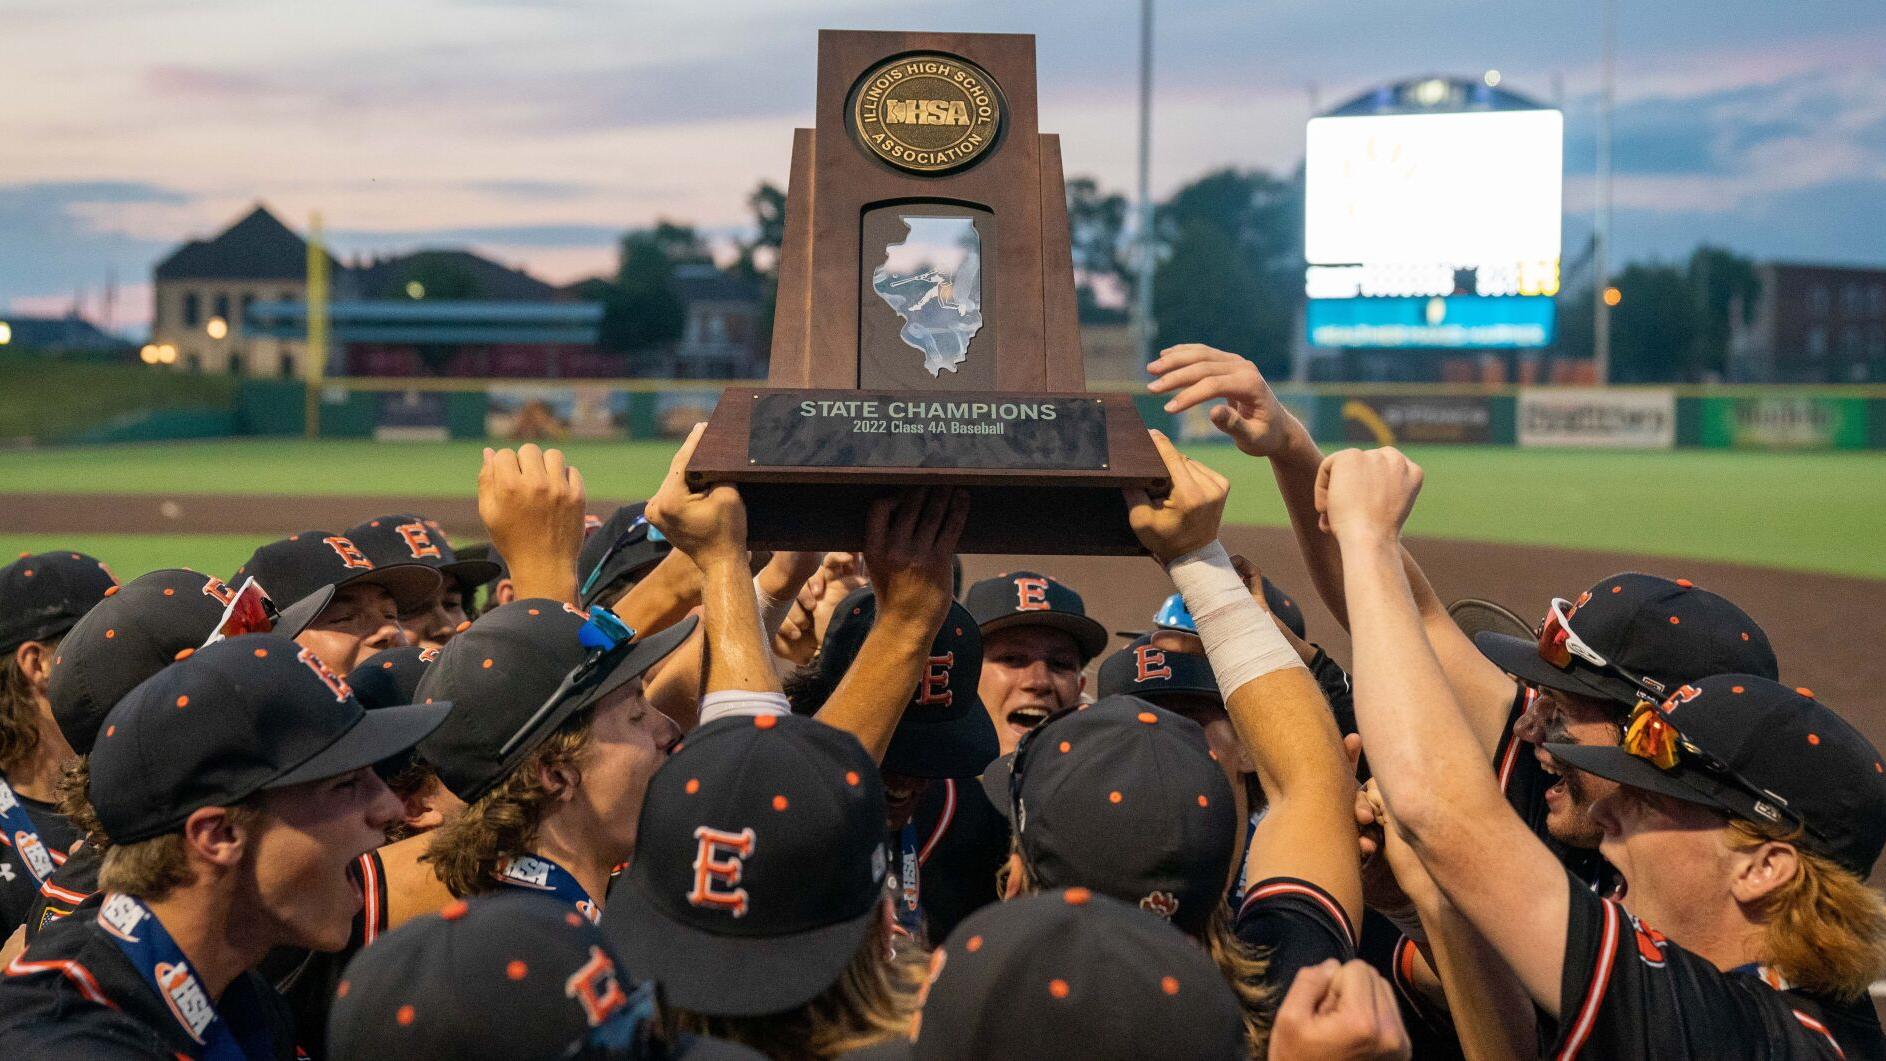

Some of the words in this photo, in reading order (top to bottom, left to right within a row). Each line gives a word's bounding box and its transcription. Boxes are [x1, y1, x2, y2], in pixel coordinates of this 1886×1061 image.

[863, 69, 903, 123] ILLINOIS
[906, 63, 951, 76] HIGH
[953, 71, 992, 125] SCHOOL
[872, 133, 982, 164] ASSOCIATION
[800, 400, 879, 418] STATE
[888, 402, 1057, 421] CHAMPIONS
[853, 420, 887, 433] 2022
[890, 421, 924, 434] Class
[928, 422, 947, 434] 4A
[950, 422, 1005, 435] Baseball
[322, 536, 374, 570] E
[395, 522, 442, 559] E
[1014, 578, 1051, 611] E
[916, 650, 954, 707] E
[1134, 644, 1172, 683] E
[686, 825, 756, 918] E
